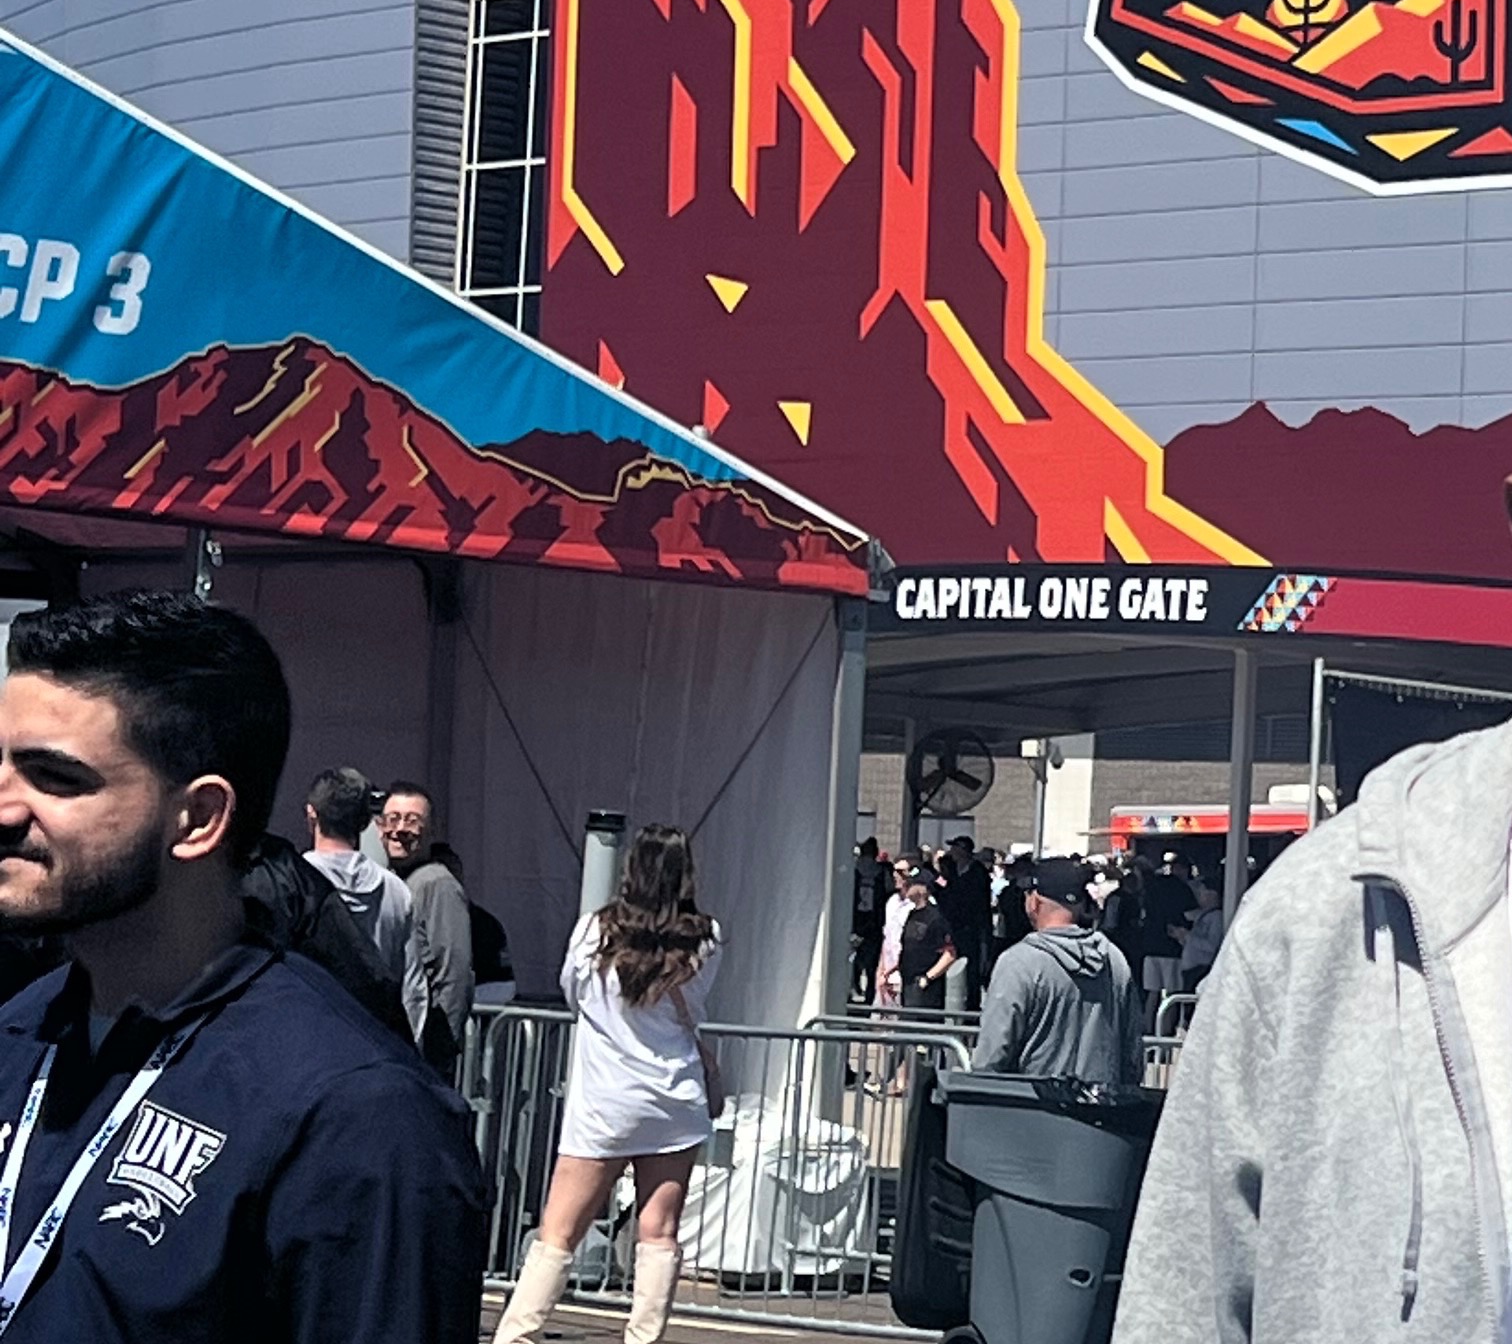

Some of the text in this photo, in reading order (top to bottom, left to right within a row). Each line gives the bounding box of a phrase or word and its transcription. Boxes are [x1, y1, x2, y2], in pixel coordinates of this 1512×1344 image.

[93, 251, 151, 335] 3
[897, 577, 1208, 621] CAPITAL ONE GATE
[124, 1107, 221, 1186] UNF
